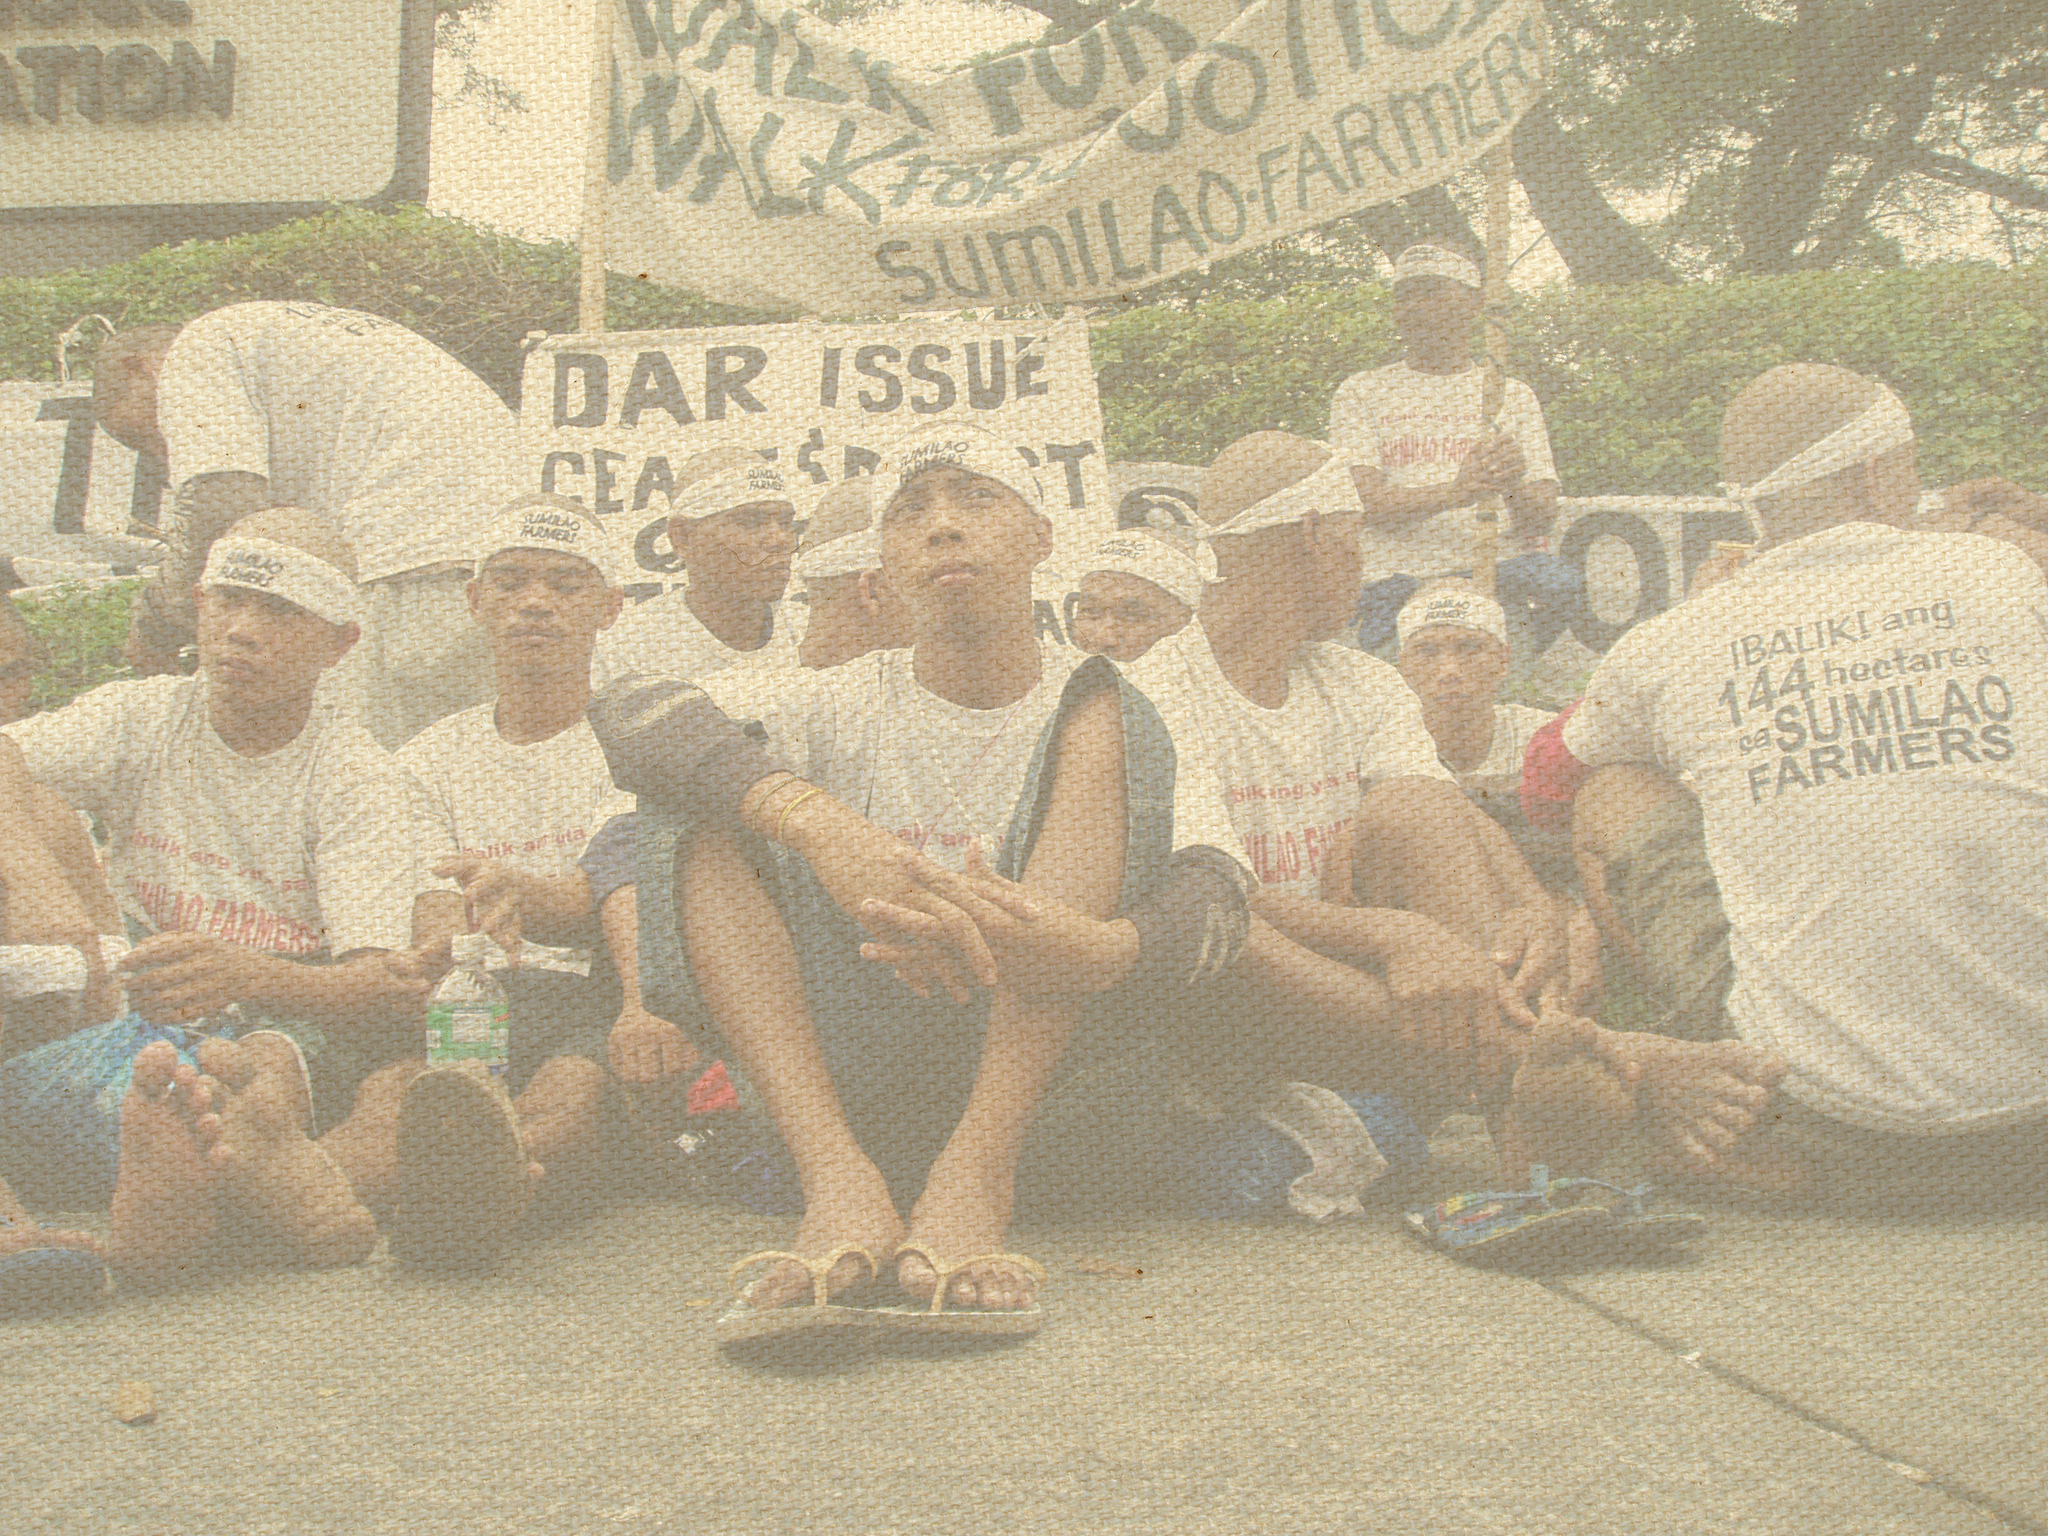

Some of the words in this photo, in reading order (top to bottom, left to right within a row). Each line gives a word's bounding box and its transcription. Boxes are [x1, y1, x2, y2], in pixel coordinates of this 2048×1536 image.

[607, 55, 923, 226] WALK
[552, 344, 769, 431] DAR
[819, 335, 1049, 414] ISSUE
[1881, 600, 1956, 630] ang
[1719, 657, 1815, 727] 144
[1823, 645, 1992, 687] hectares
[1739, 727, 1771, 757] sa
[1774, 675, 2014, 754] SUMILAO
[1748, 724, 2016, 805] FARMERS
[208, 899, 321, 954] FARMERS
